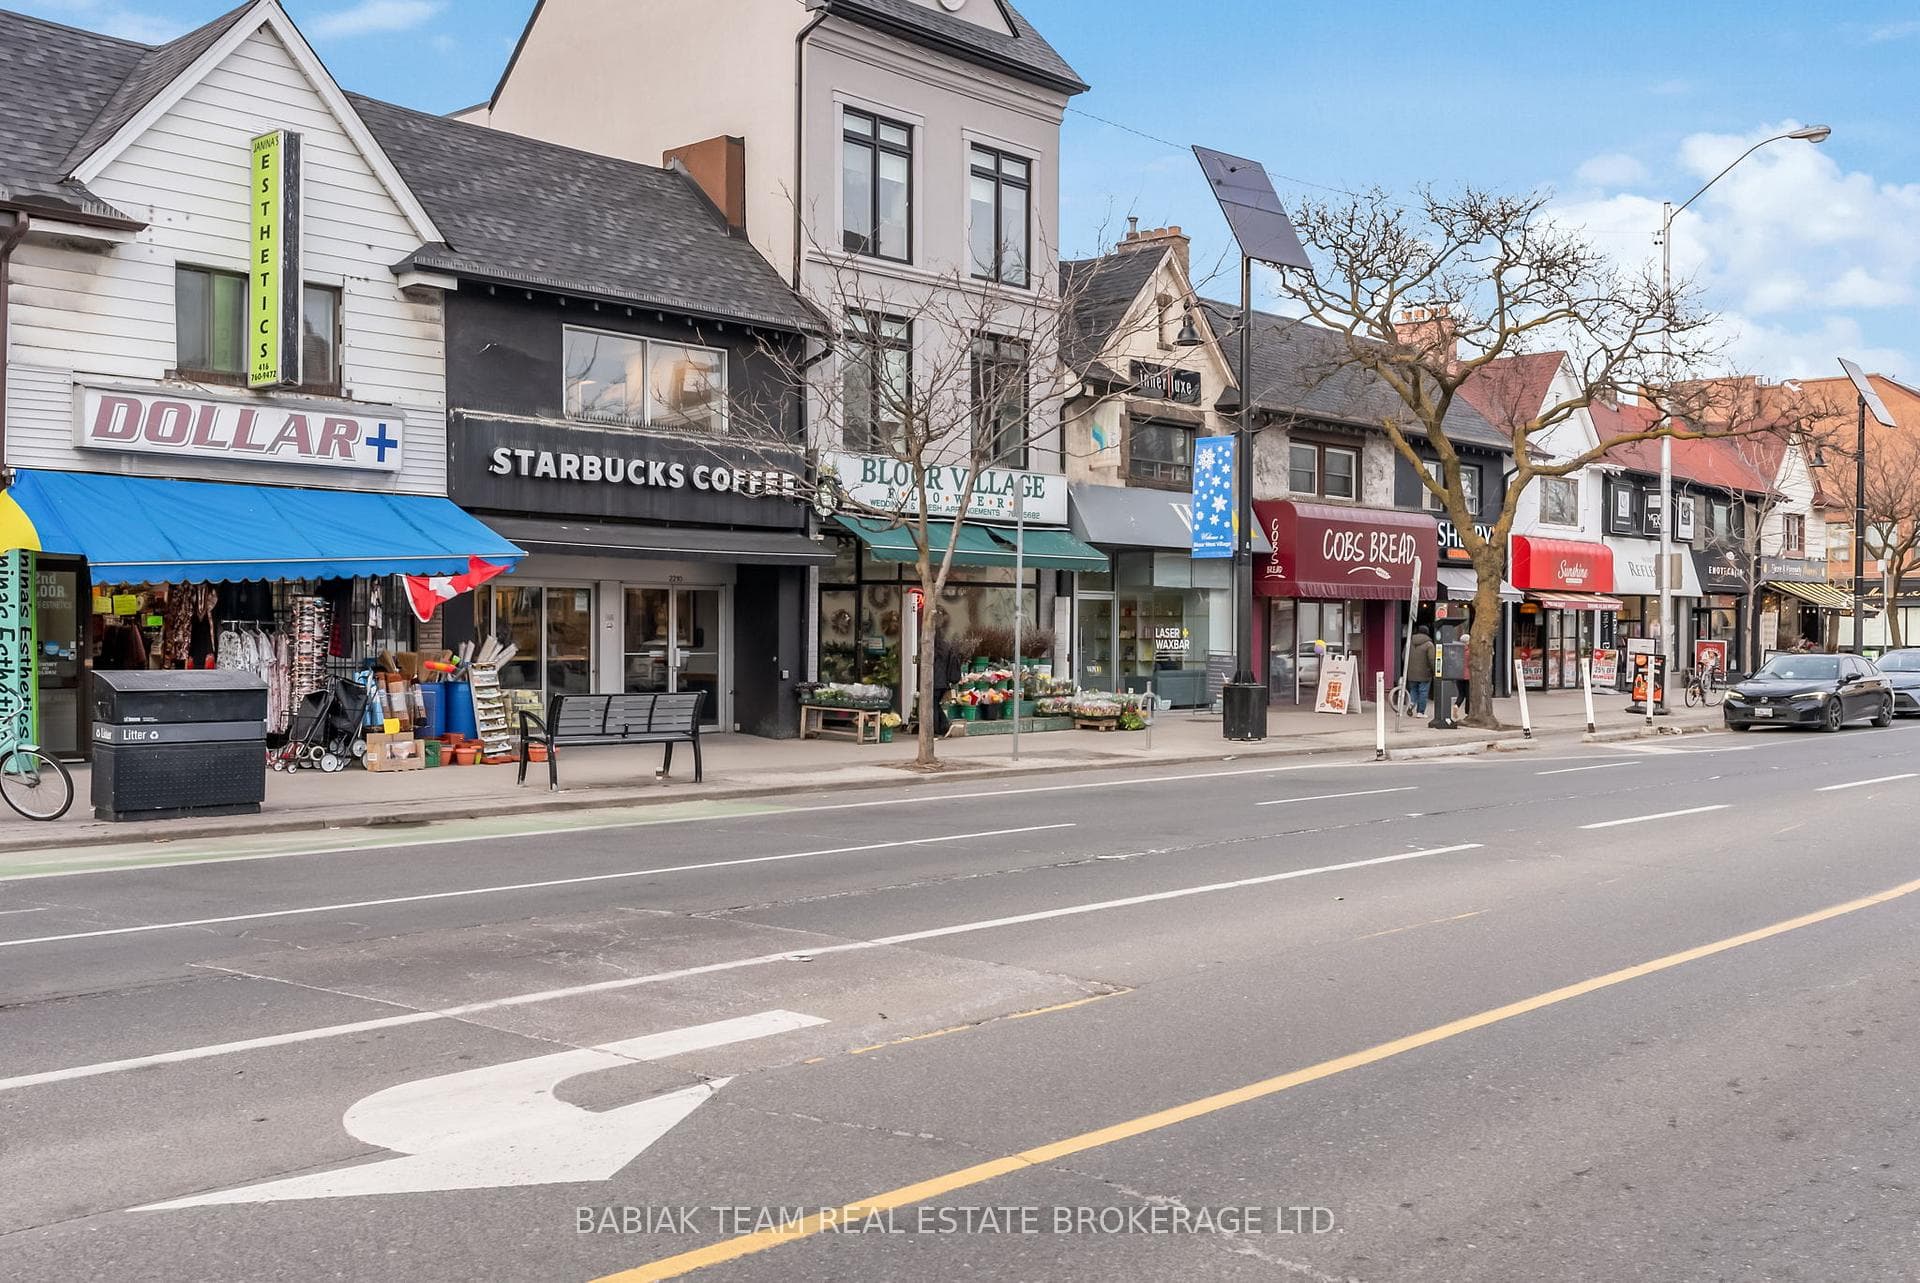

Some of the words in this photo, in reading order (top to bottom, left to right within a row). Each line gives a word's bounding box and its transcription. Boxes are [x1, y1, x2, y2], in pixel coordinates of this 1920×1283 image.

[260, 153, 270, 358] ESTHETICS
[493, 447, 685, 488] STARBUCKS
[692, 465, 796, 496] COFFEE
[950, 467, 1045, 499] VLLAGE
[870, 499, 907, 510] WEDD
[945, 506, 1000, 516] ARGEMENTS
[1271, 518, 1279, 565] COBS
[1323, 528, 1365, 561] COBS
[1369, 531, 1416, 564] BREAD
[0, 549, 16, 618] nina's
[20, 549, 32, 618] nina's
[1558, 559, 1588, 579] Sunshine
[1628, 561, 1655, 578] REFLE
[37, 585, 64, 597] OOR
[1155, 628, 1180, 638] LASER
[1155, 640, 1190, 649] WAXBAR
[20, 627, 32, 739] Esthetics
[123, 729, 147, 740] Litter
